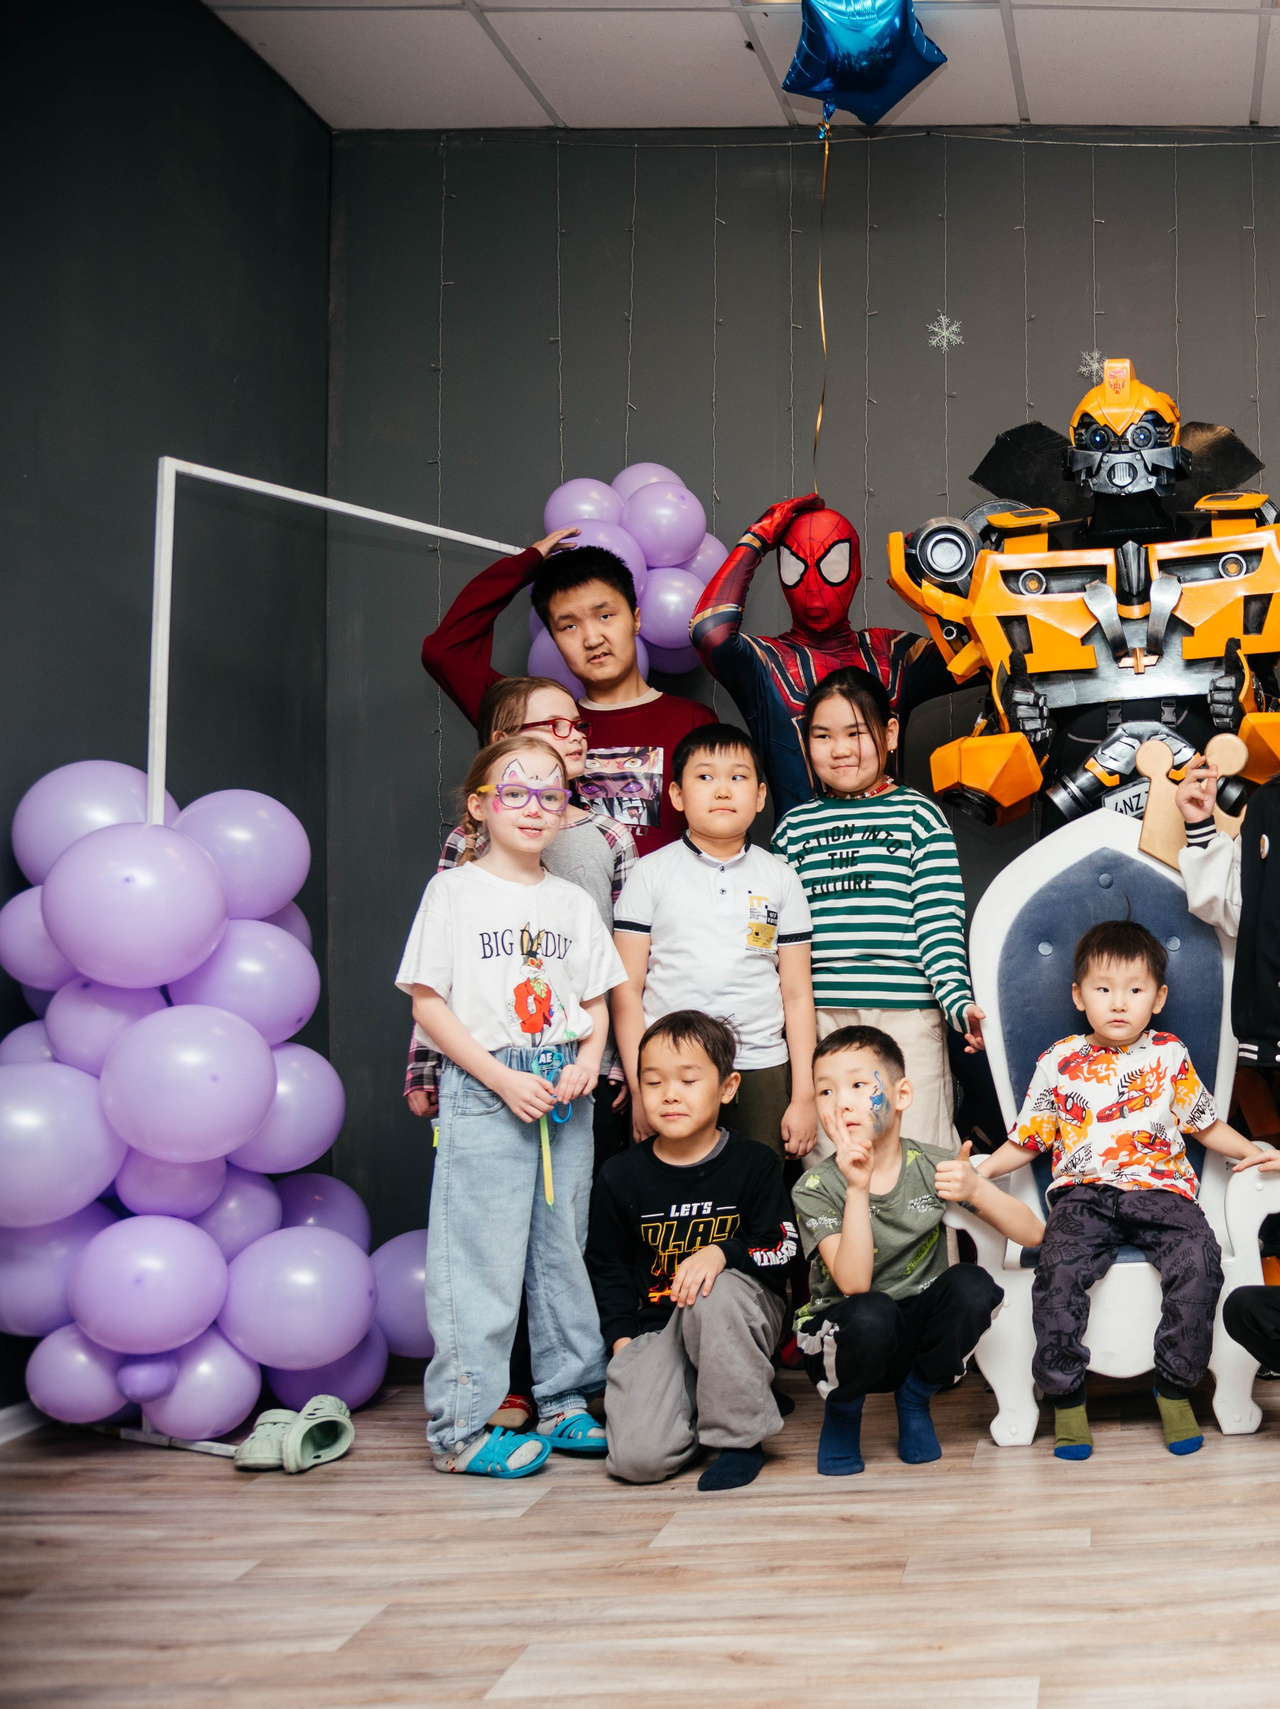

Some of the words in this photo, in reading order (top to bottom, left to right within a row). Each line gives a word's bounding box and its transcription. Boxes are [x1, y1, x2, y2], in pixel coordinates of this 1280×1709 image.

[795, 823, 856, 866] ACTION
[861, 825, 904, 855] INTO
[828, 850, 859, 870] THE
[811, 873, 876, 897] FUTURE
[479, 928, 514, 959] BIG
[669, 1201, 713, 1218] LET'S
[641, 1214, 740, 1256] PLAY
